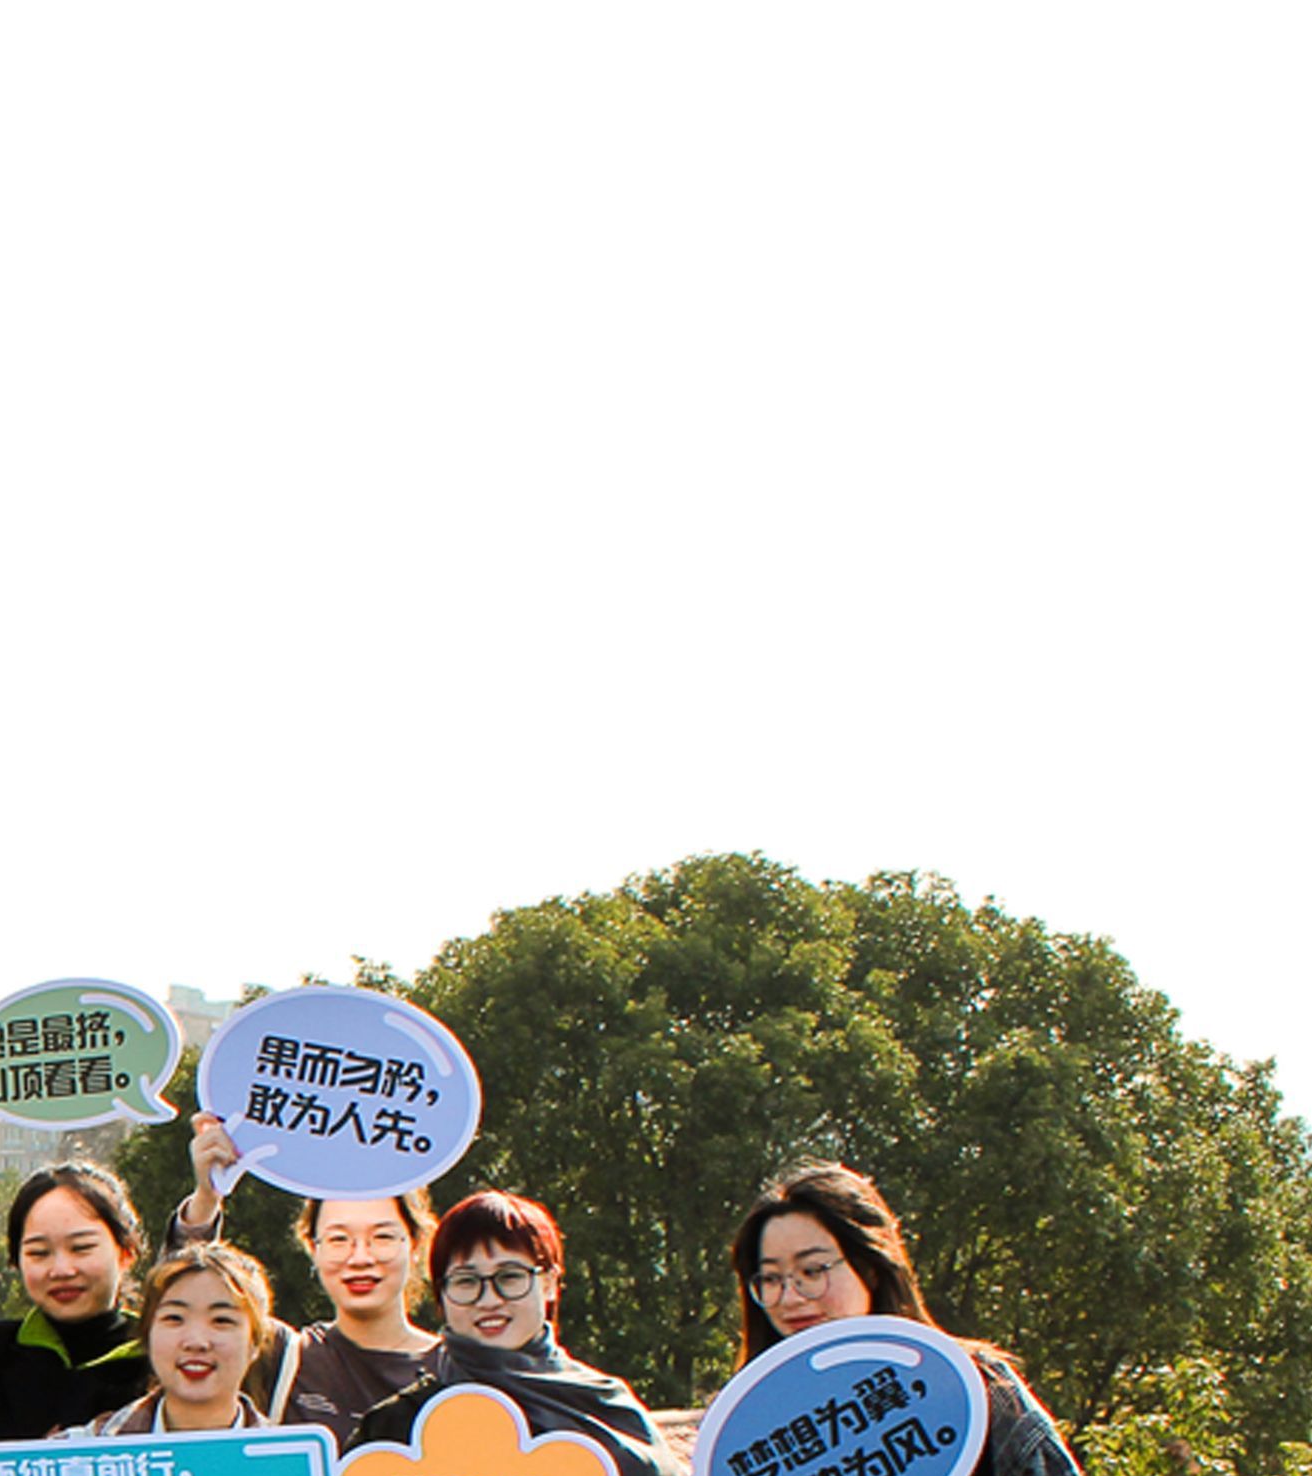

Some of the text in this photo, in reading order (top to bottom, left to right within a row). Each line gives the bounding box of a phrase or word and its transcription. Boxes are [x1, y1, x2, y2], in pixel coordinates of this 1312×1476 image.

[255, 1034, 440, 1107] 果而勿矜，
[245, 1082, 432, 1155] 敢为人先。
